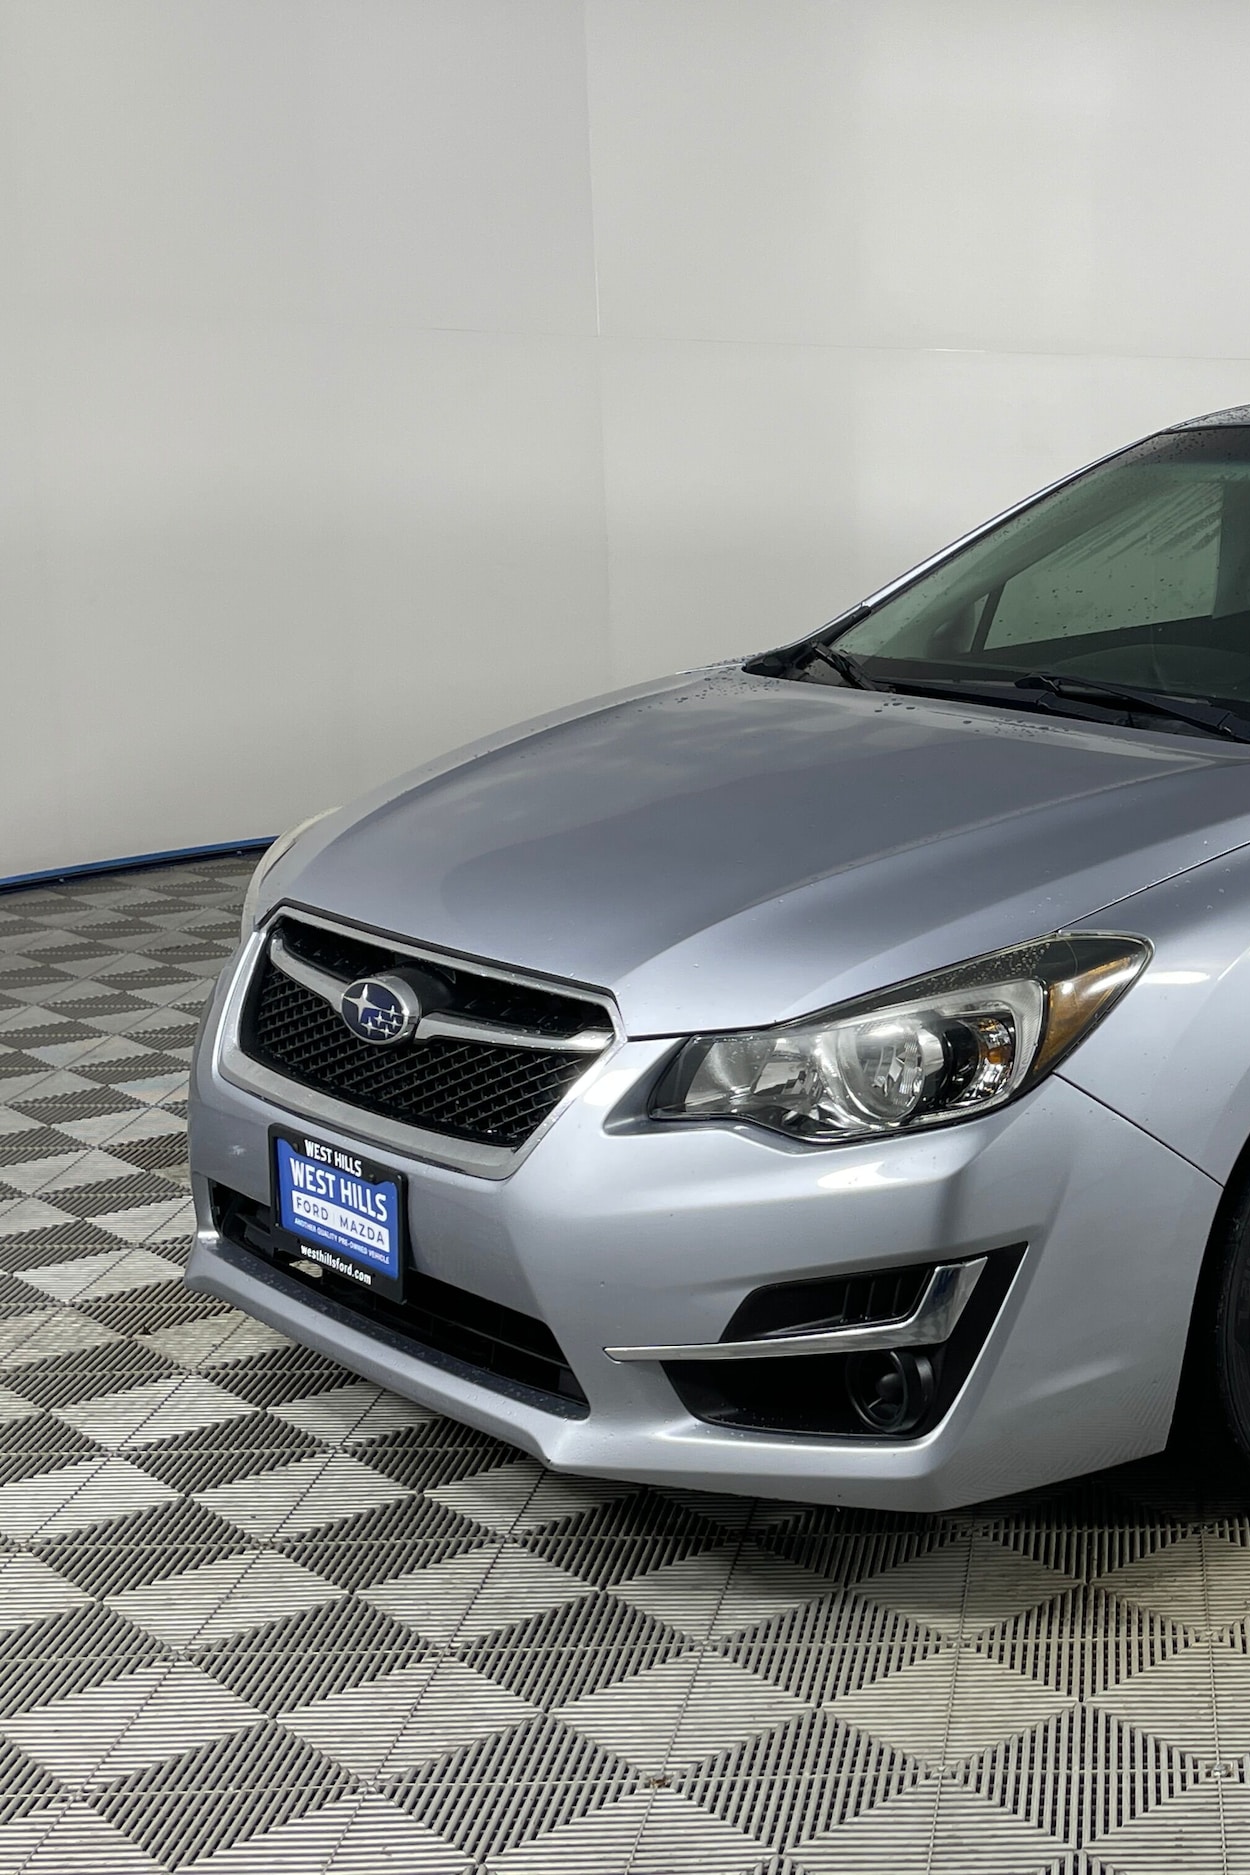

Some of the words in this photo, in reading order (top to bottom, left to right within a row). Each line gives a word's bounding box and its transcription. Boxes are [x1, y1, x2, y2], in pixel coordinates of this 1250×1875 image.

[304, 1139, 333, 1164] WEST
[334, 1151, 362, 1177] HILLS
[289, 1157, 336, 1198] WEST
[340, 1178, 388, 1222] HILLS
[296, 1196, 328, 1221] FORD
[340, 1215, 385, 1245] MAZDA
[300, 1245, 372, 1285] westhillsford.com
